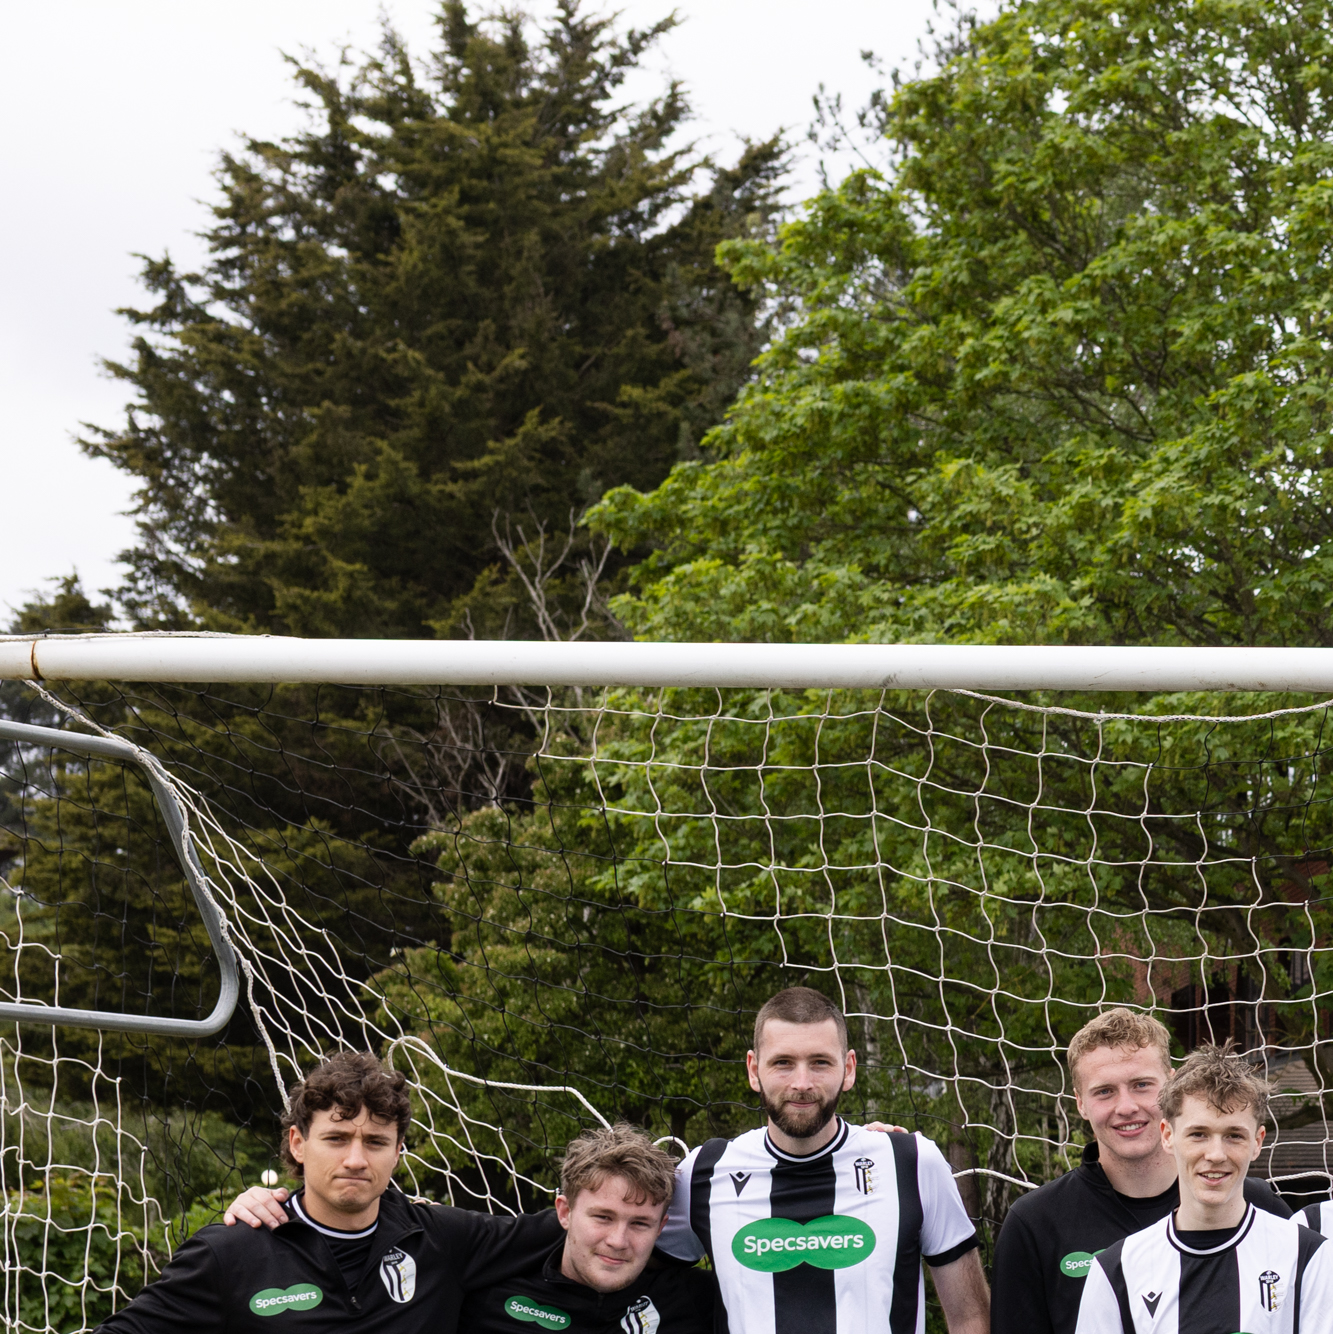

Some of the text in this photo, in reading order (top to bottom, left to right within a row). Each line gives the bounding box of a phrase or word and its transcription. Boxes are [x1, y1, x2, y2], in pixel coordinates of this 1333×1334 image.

[744, 1234, 864, 1255] Specsavers
[1065, 1259, 1093, 1270] Specs
[255, 1291, 317, 1309] Specsavers
[510, 1301, 566, 1323] Specsavers
